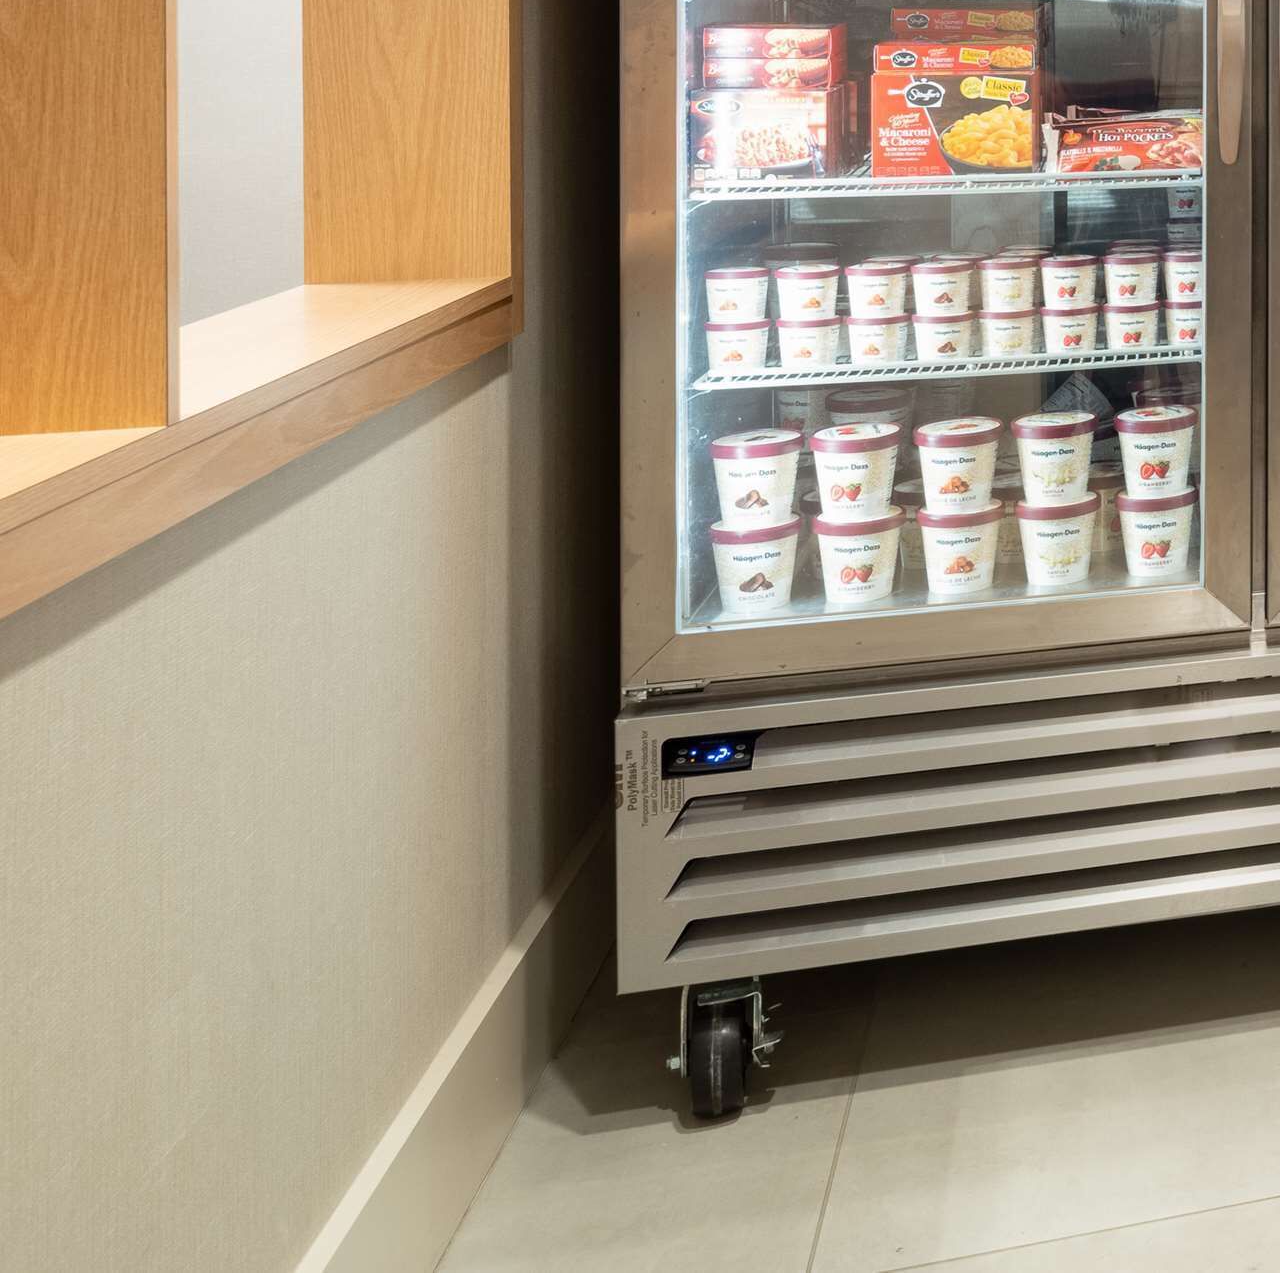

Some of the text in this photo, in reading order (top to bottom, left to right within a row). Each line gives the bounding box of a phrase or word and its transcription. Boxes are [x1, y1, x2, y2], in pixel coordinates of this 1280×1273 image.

[985, 80, 1022, 93] Classic
[879, 128, 931, 137] Macaroni
[890, 137, 930, 146] Cheese
[627, 762, 638, 811] PolyMask
